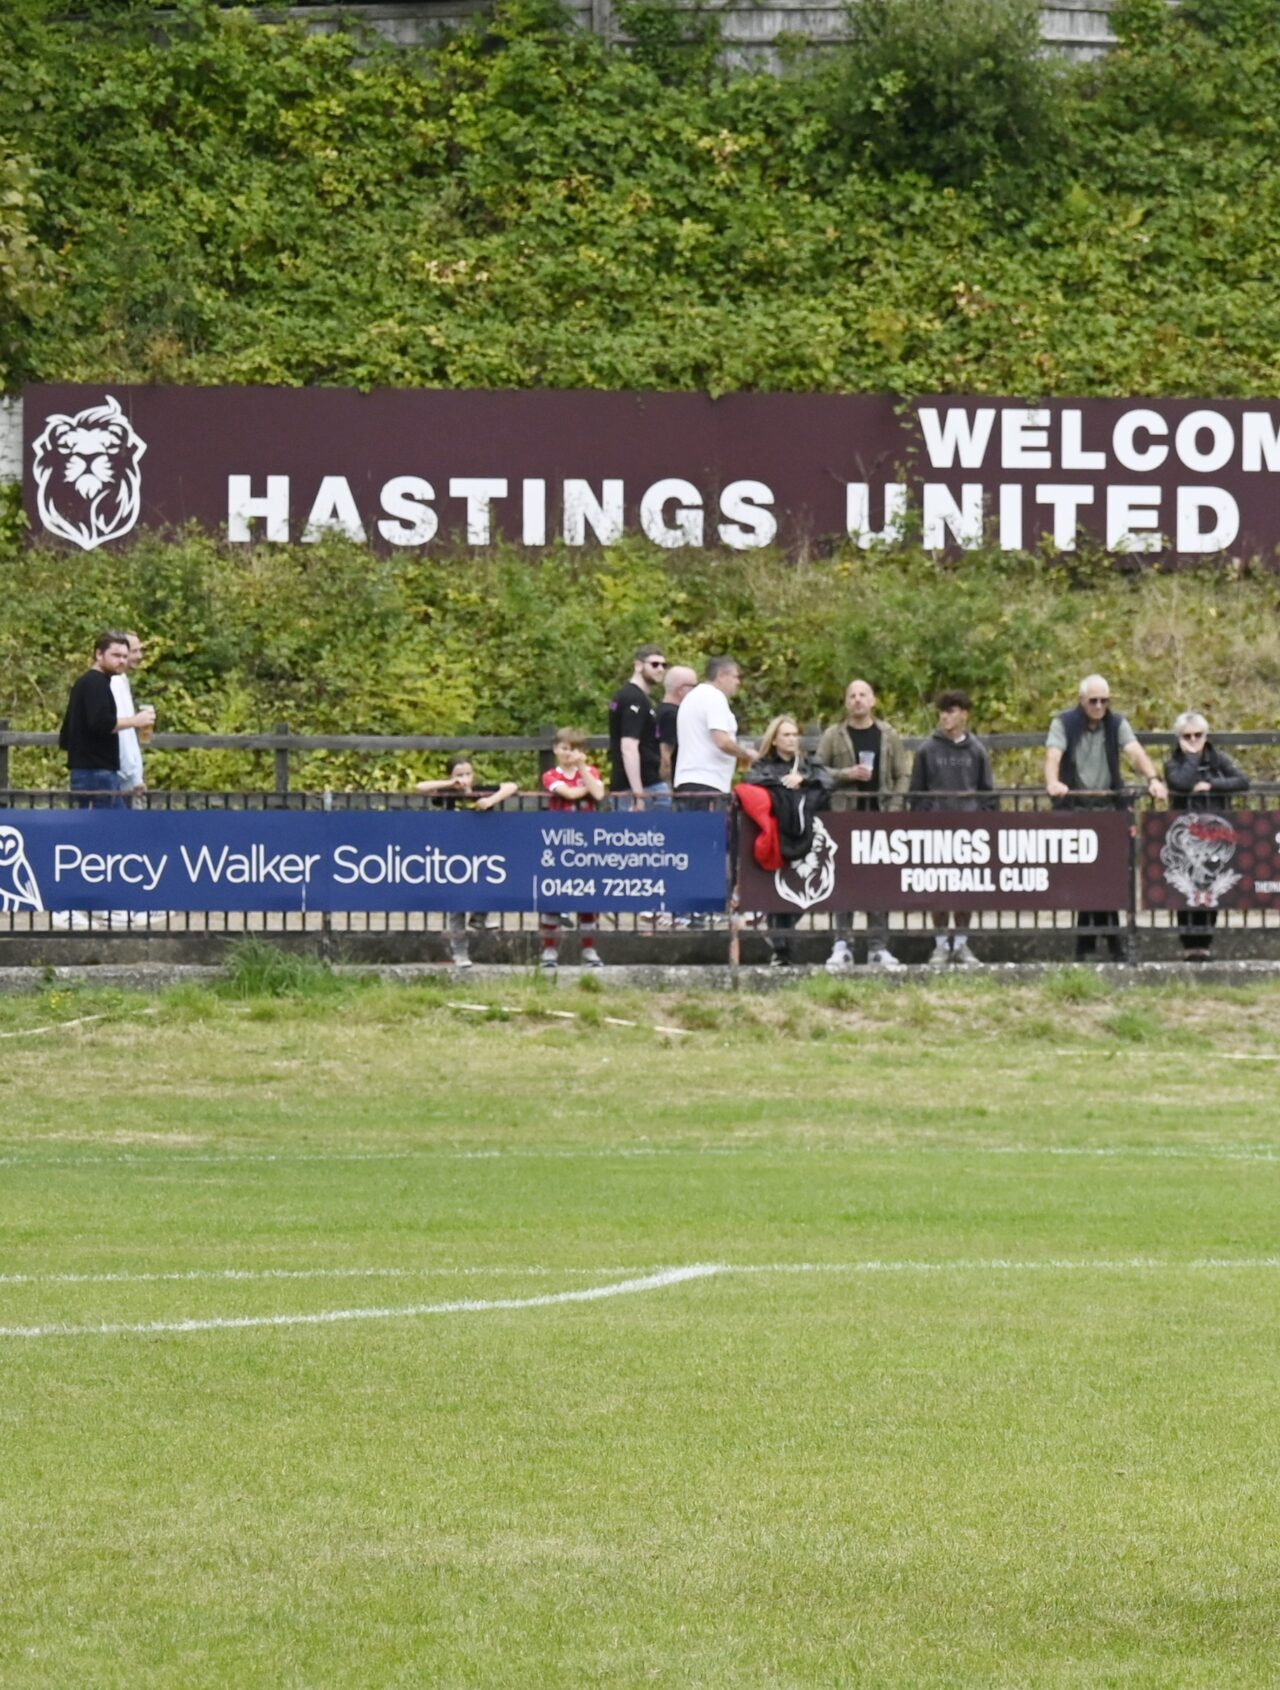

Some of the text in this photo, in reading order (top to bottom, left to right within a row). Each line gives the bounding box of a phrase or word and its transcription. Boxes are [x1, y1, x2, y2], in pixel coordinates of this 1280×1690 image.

[227, 475, 778, 550] HASTINGS
[846, 483, 1240, 554] UNITED
[541, 828, 666, 848] Wills, Probate
[850, 828, 1099, 865] HASTINGS UNITED
[54, 843, 507, 891] Percy Walker Solicitors
[540, 849, 689, 871] & Conveyancing
[541, 878, 666, 897] 01424 721234
[900, 867, 1049, 893] FOOTBALL CLUB
